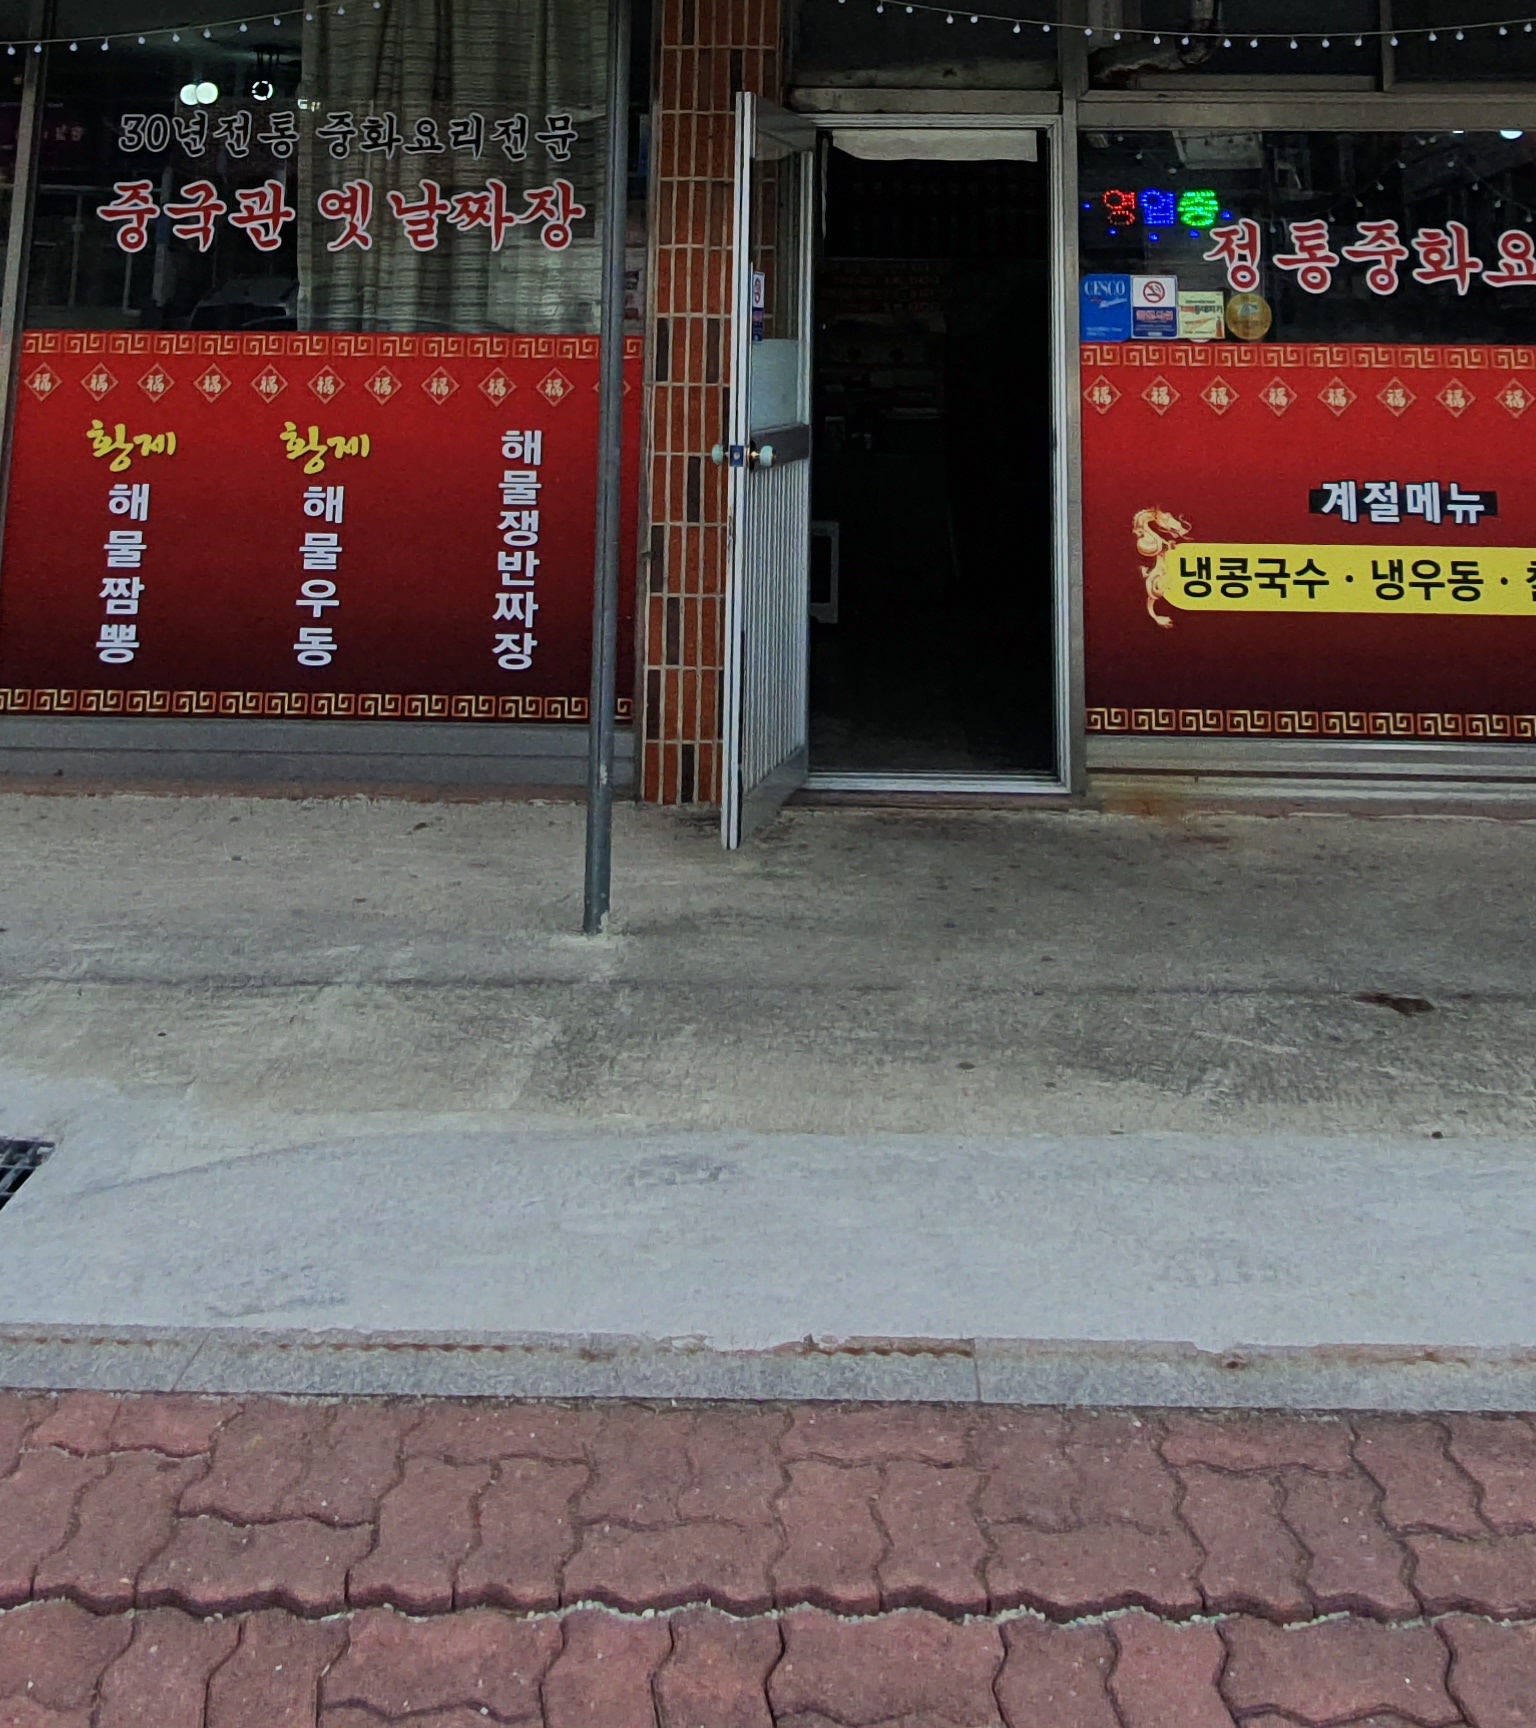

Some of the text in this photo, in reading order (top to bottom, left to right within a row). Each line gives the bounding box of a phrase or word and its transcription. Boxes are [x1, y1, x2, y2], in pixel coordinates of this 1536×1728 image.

[117, 109, 301, 160] 30년전통
[316, 110, 579, 162] 중화요리전문
[95, 177, 587, 254] 중국관 옛날짜장
[1101, 188, 1220, 228] 영업중
[86, 418, 177, 472] 황제
[279, 420, 371, 475] 황제
[1320, 480, 1487, 526] 계절메뉴
[95, 482, 151, 665] 해물짬뽕
[292, 484, 345, 668] 해물우동
[490, 429, 544, 671] 해물쟁반짜장
[1178, 555, 1331, 600] 냉콩국수
[1369, 557, 1485, 602] 냉우동
